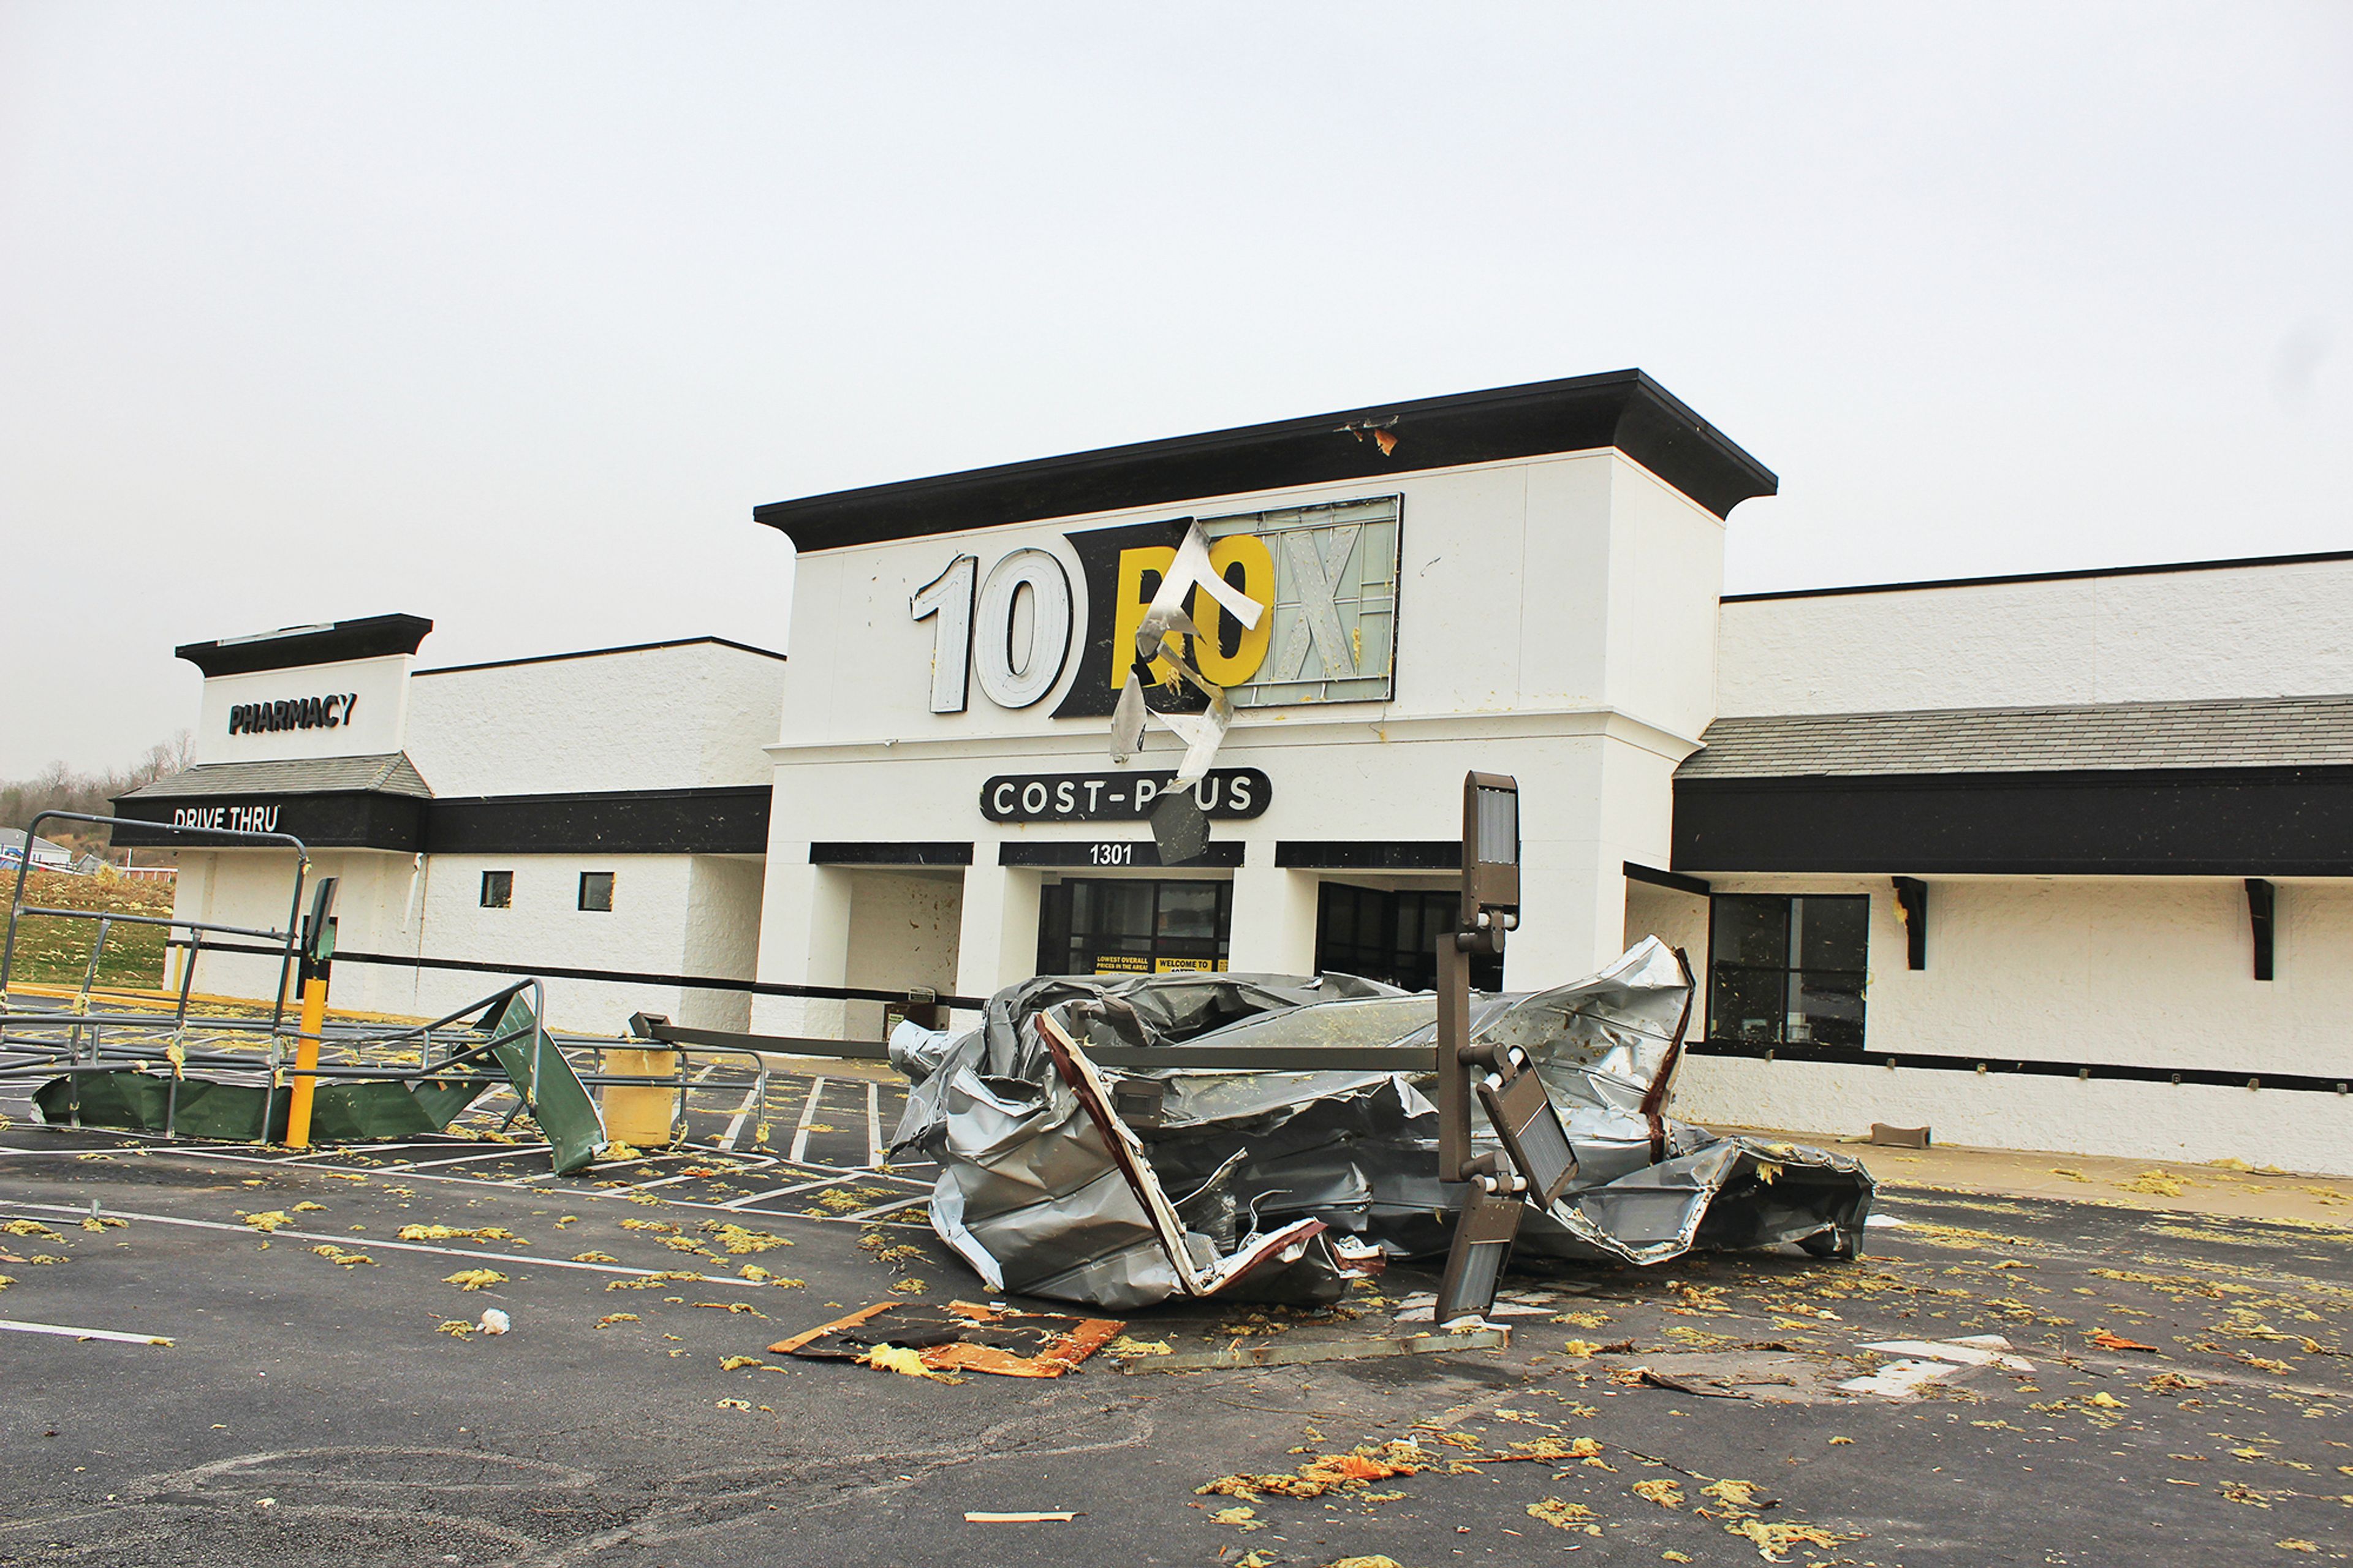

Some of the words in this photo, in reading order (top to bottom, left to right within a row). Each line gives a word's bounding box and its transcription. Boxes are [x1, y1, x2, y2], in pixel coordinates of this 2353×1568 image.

[911, 547, 1074, 714] 10
[229, 692, 358, 735] PHARMACY
[993, 776, 1252, 814] COST-PUS
[175, 807, 226, 833] DRIVE
[229, 806, 279, 833] THRU
[1089, 844, 1132, 865] 1301
